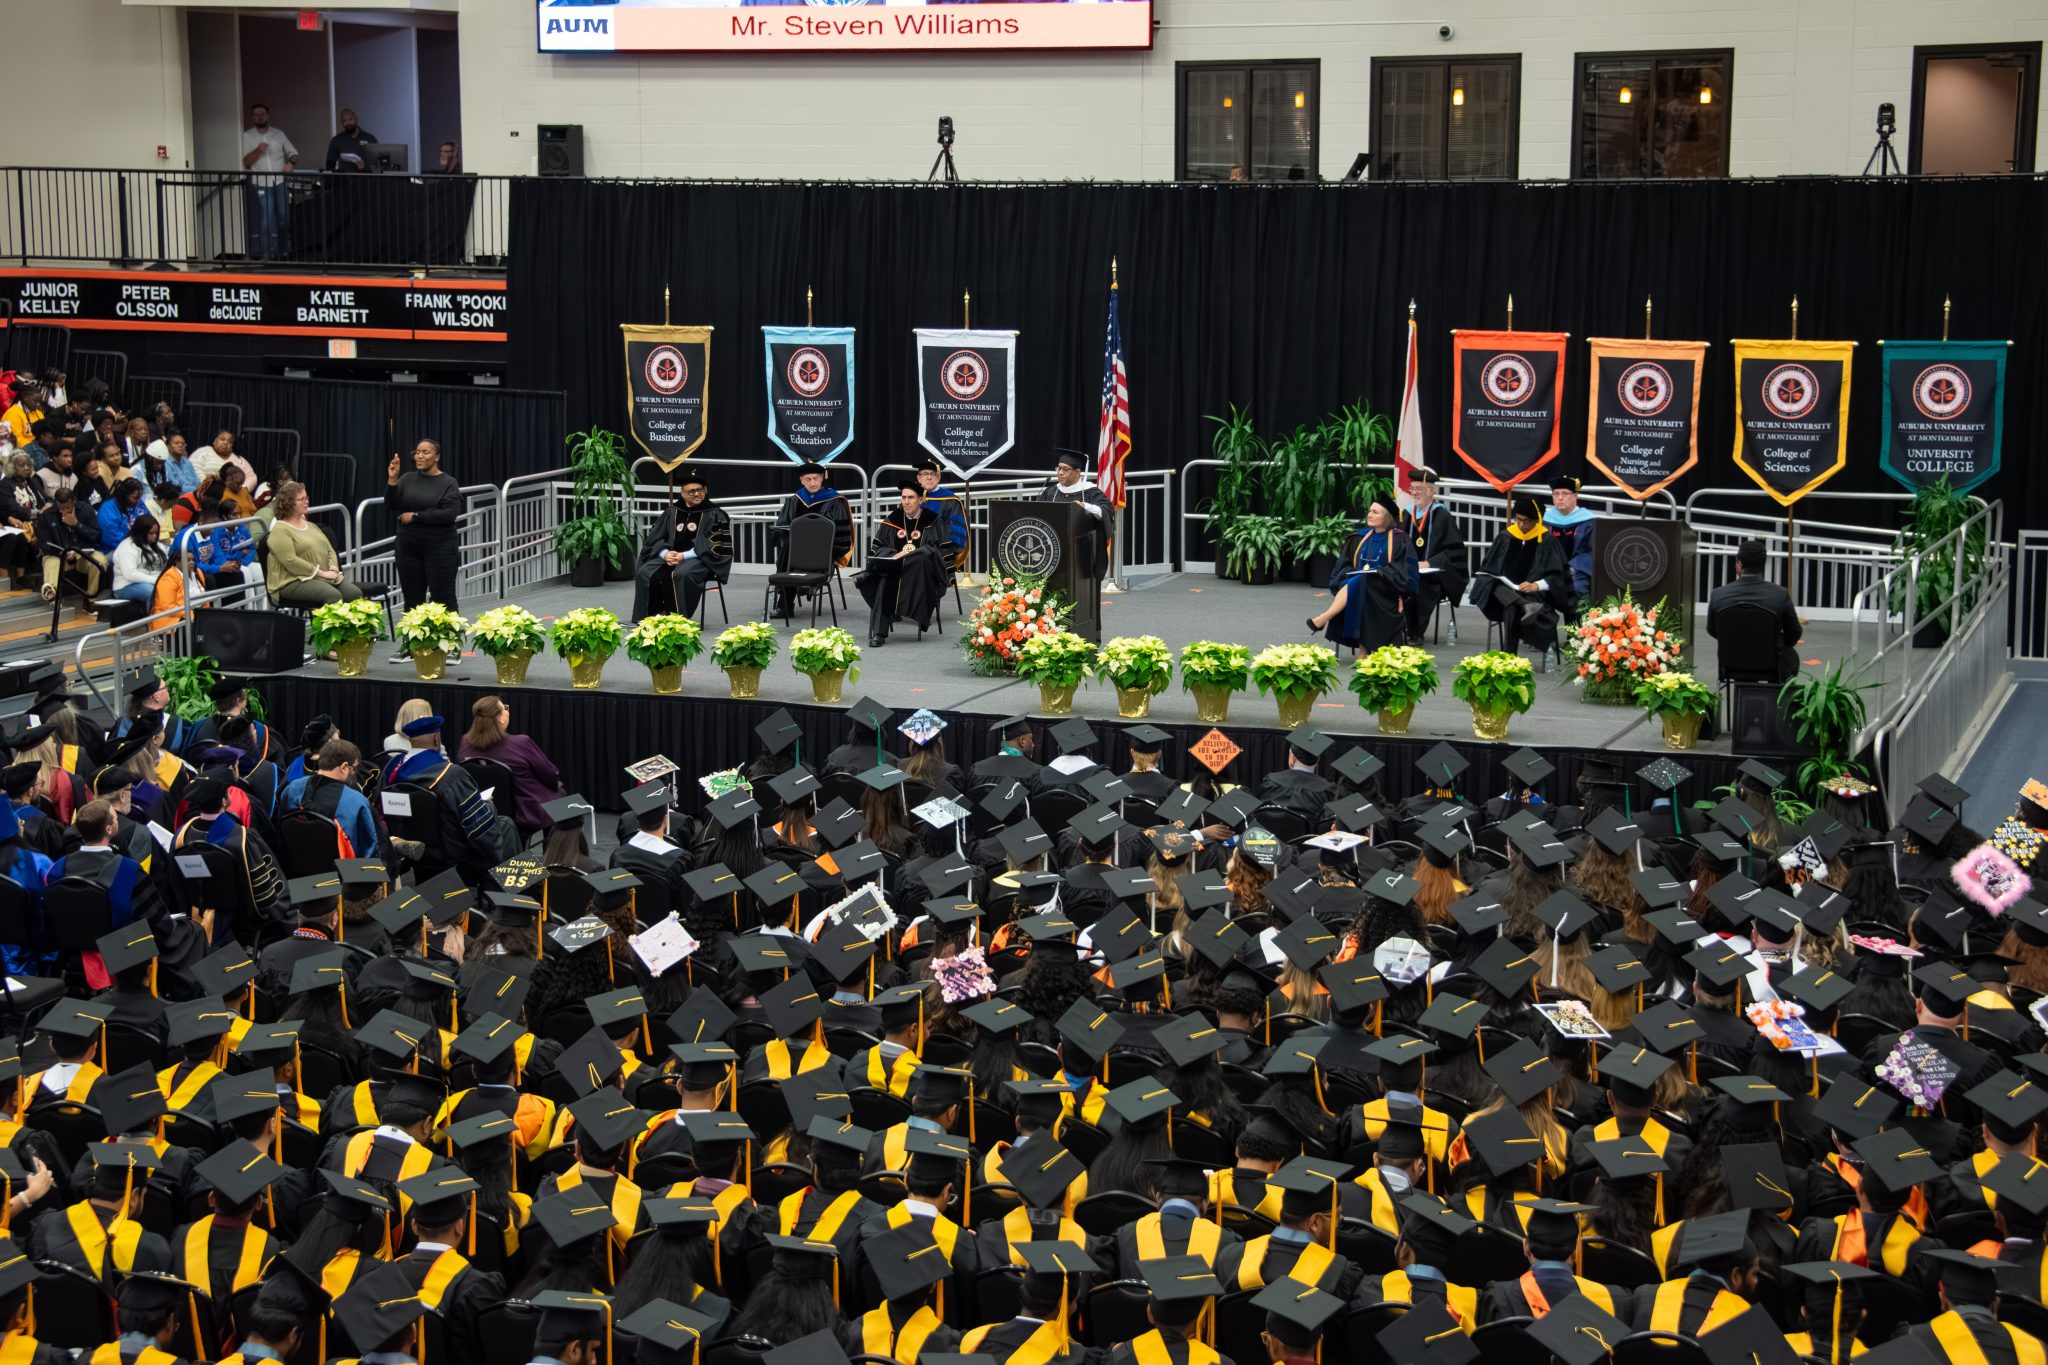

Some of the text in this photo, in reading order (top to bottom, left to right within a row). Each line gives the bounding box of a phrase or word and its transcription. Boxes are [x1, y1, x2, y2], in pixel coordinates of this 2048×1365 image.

[546, 19, 608, 34] AUM
[732, 14, 1019, 36] Mr. Steven Williams
[21, 283, 78, 297] JUNIOR
[122, 285, 170, 300] PETER
[212, 288, 260, 303] ELLEN
[310, 291, 355, 306] KATIE
[405, 293, 453, 309] FRANK
[19, 300, 80, 314] KELLEY
[116, 302, 178, 318] OLSSON
[210, 306, 262, 321] deCLOUET
[297, 307, 369, 323] BARNETT
[432, 312, 494, 327] WILSON
[1467, 408, 1499, 416] AUBURN
[648, 420, 686, 431] College of
[1486, 421, 1536, 429] MONTGOMERY
[1604, 417, 1685, 428] AUBURN UNIVERSITY
[1782, 422, 1832, 430] UNIVERSITY
[1898, 422, 1986, 431] AUBURN UNIVERSITY
[791, 423, 827, 434] College of
[944, 428, 984, 438] College of
[649, 432, 686, 442] Business
[790, 435, 832, 445] Education
[1624, 430, 1673, 439] MONTGOMERY
[1766, 433, 1821, 441] MONTGOMERY
[941, 439, 963, 447] Liberal
[961, 448, 989, 456] Sciences
[1620, 444, 1665, 457] College of
[1763, 448, 1811, 460] College of
[1907, 449, 1974, 459] UNIVERSITY
[1620, 456, 1661, 468] Nursing and
[1764, 461, 1811, 473] Sciences
[1906, 460, 1974, 473] COLLEGE
[1614, 465, 1670, 476] Health Sciences
[566, 921, 598, 930] MARK
[1916, 1072, 1956, 1080] GRADUATED
